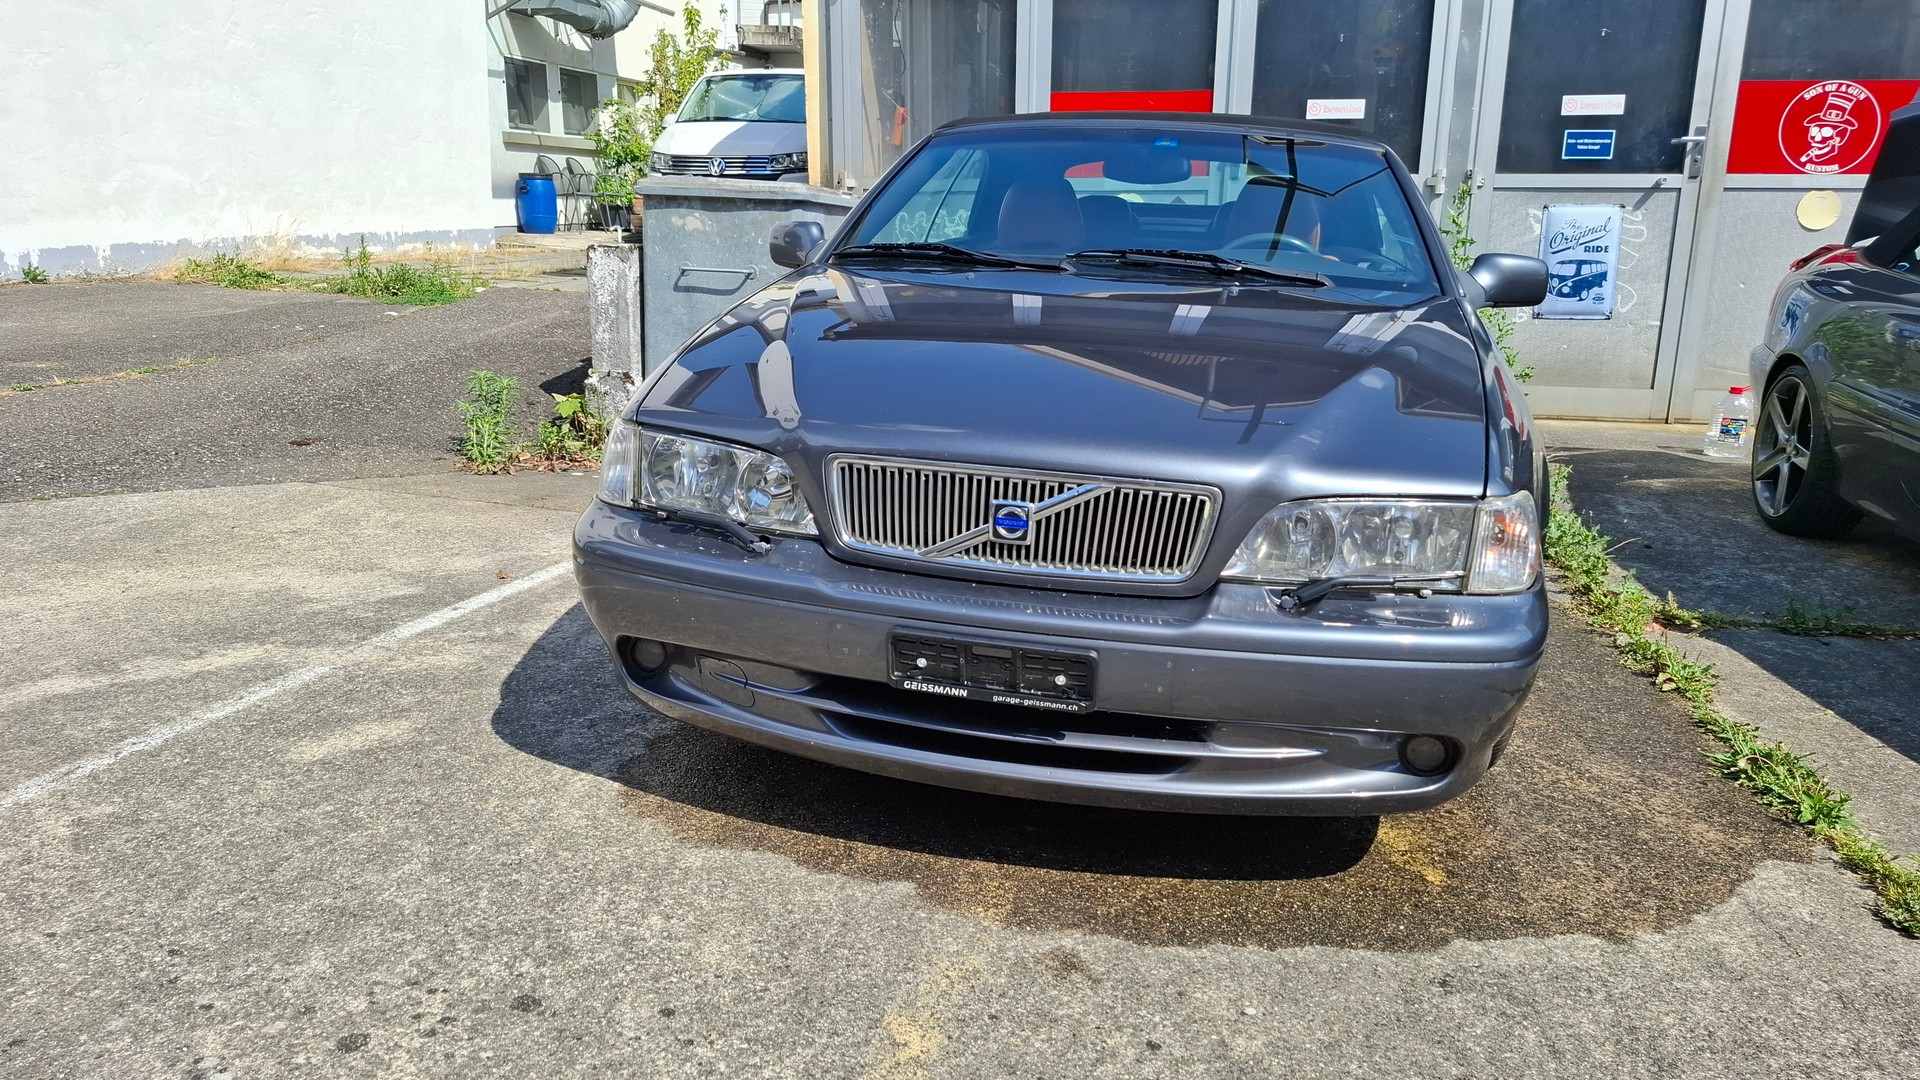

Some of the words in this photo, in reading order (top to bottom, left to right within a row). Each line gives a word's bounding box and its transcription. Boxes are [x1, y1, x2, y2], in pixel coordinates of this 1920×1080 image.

[1803, 86, 1825, 101] SON
[1825, 83, 1839, 92] OF
[1839, 84, 1847, 92] A
[1847, 85, 1868, 101] GUN
[1323, 104, 1363, 114] brembo
[1804, 163, 1840, 172] KUSTOM
[1562, 219, 1581, 231] The
[1550, 216, 1612, 251] Original
[1583, 245, 1610, 253] RIDE
[903, 680, 968, 698] GEISSMANN
[992, 693, 1079, 712] garage-geissmann.ch
